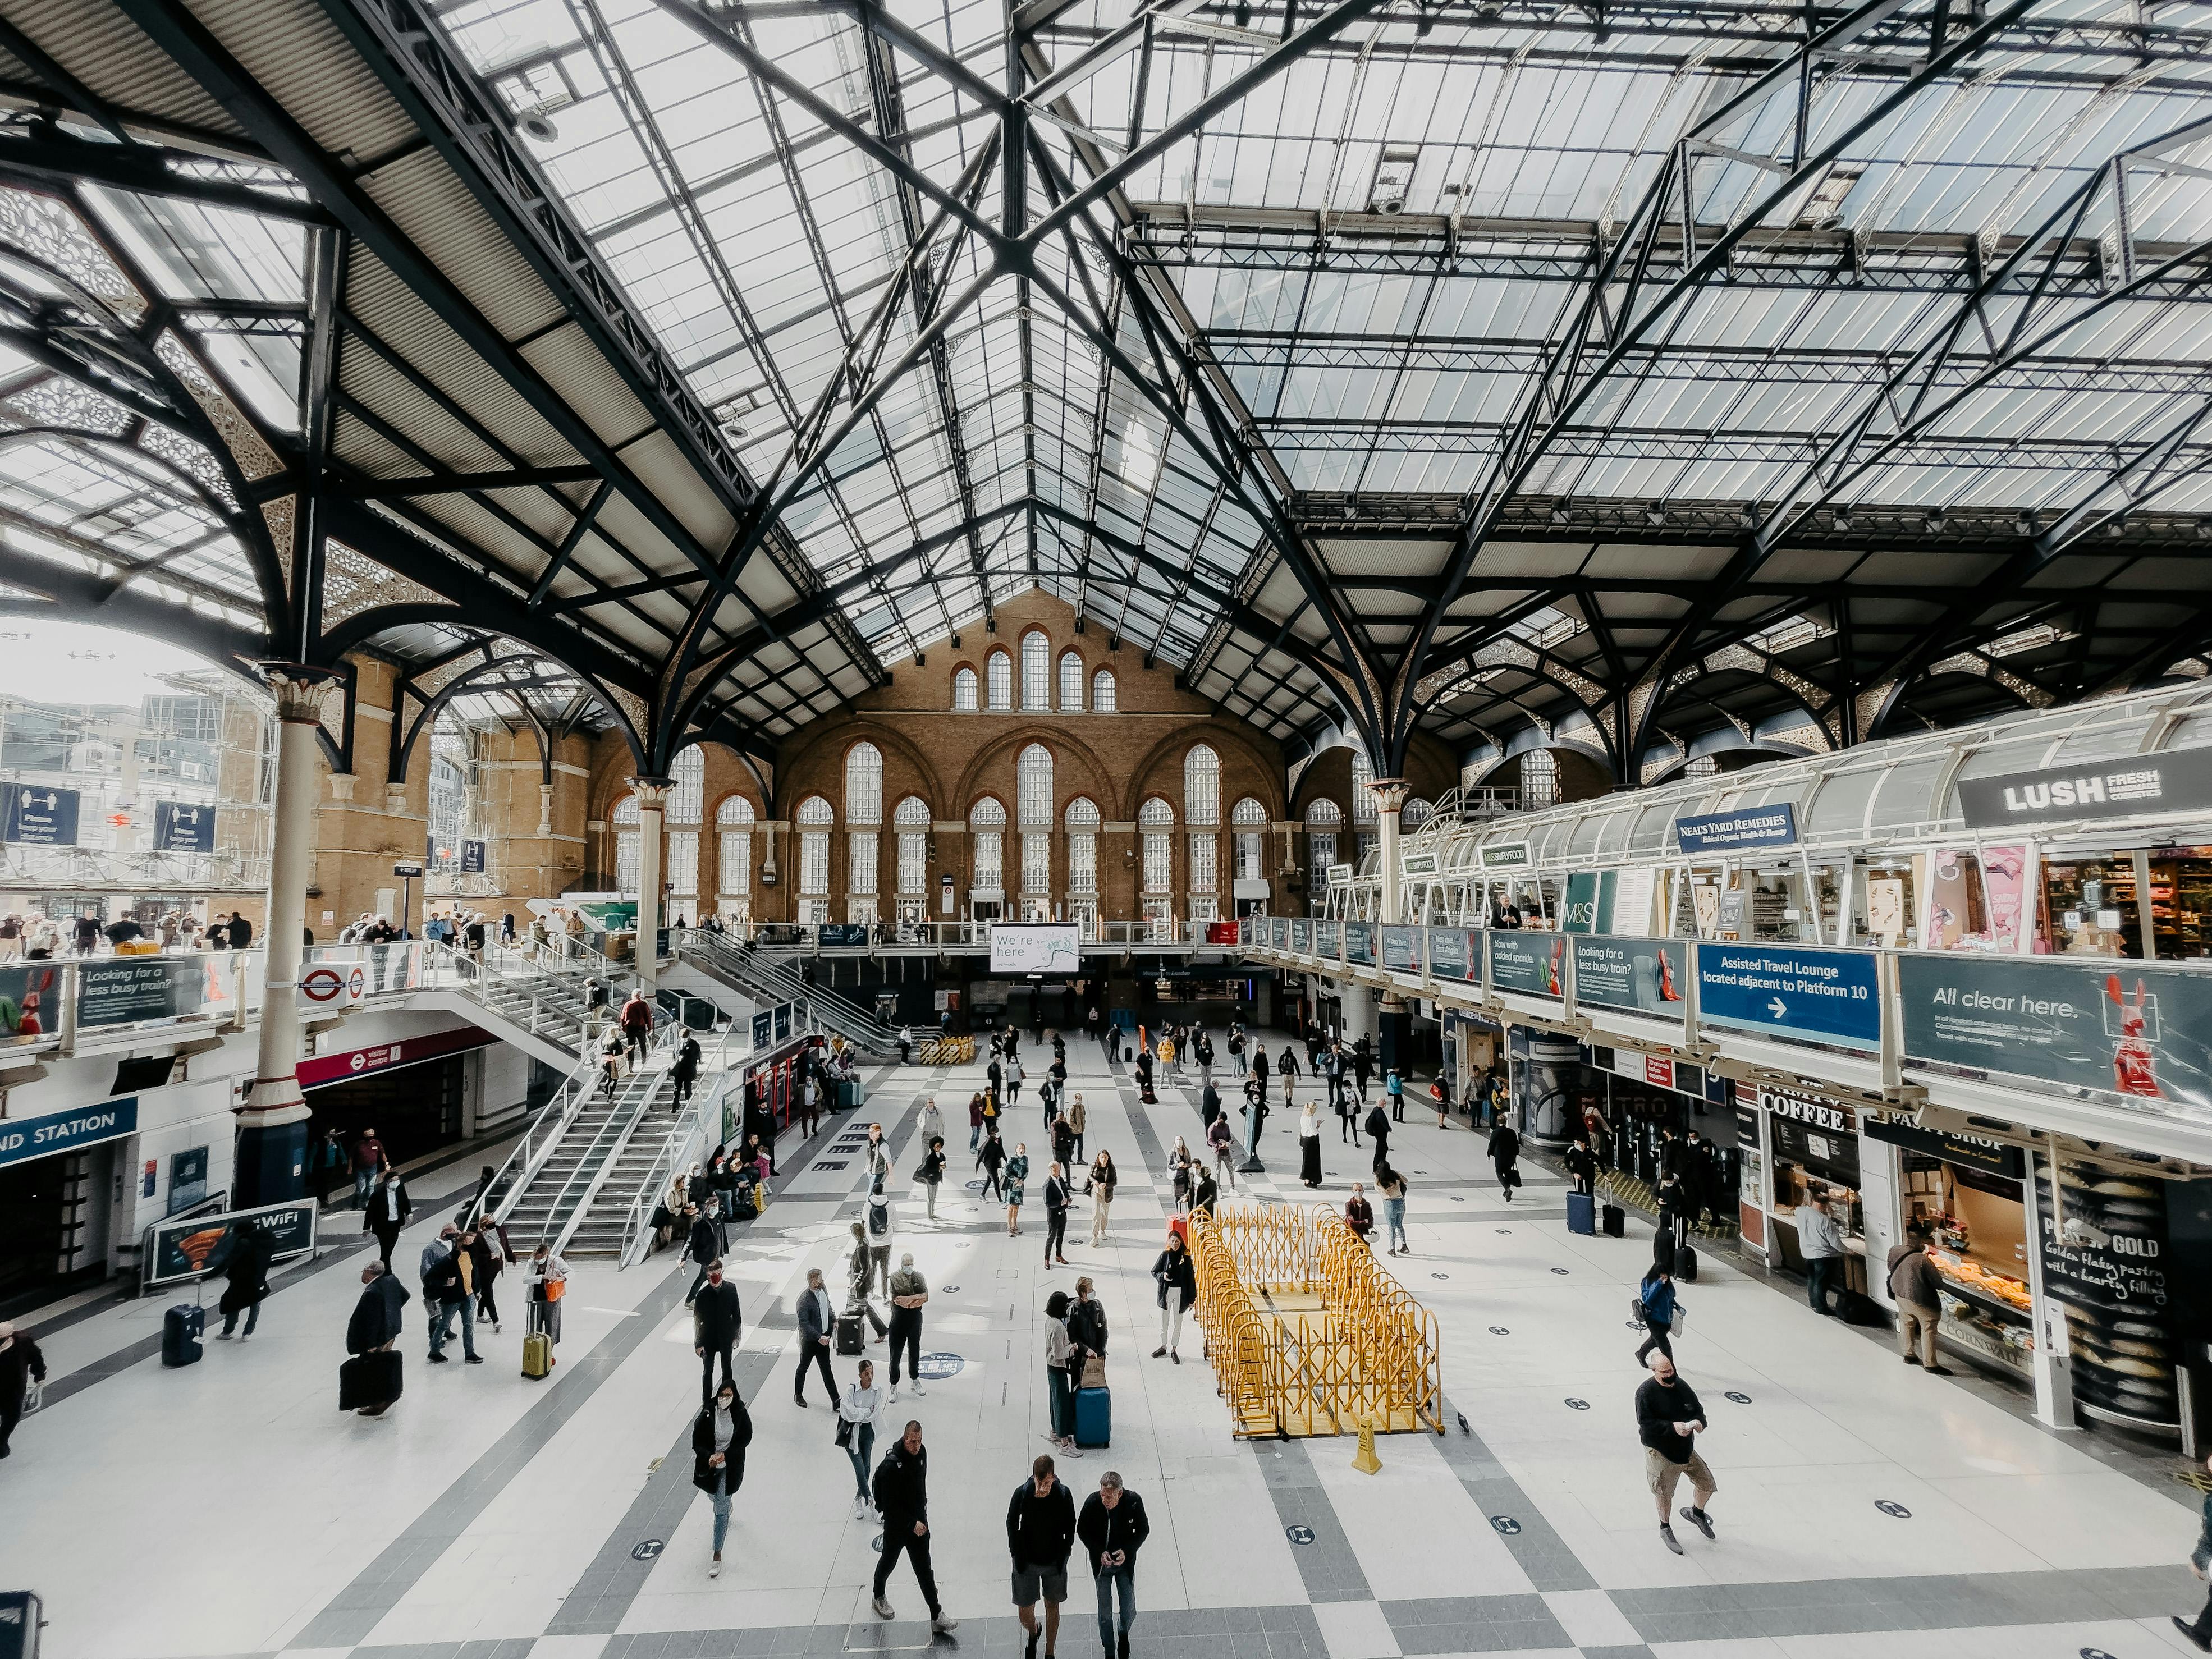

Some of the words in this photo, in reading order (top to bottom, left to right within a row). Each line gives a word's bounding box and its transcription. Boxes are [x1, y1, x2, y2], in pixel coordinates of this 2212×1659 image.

[2106, 769, 2160, 787] FRESH
[2003, 777, 2105, 811] LUSH
[1680, 824, 1708, 837] NEAL'S
[1708, 822, 1734, 834] YARD
[1734, 814, 1787, 831] REMEDIES
[1563, 902, 1593, 924] M&S
[996, 934, 1033, 945] We're
[1494, 939, 1506, 949] Now
[1506, 940, 1518, 950] with
[997, 946, 1024, 956] here
[1495, 952, 1512, 962] added
[1578, 946, 1605, 960] Looking
[1606, 947, 1617, 959] for
[1618, 951, 1624, 960] a
[86, 969, 132, 982] Looking
[136, 968, 150, 978] for
[1579, 959, 1592, 970] less
[1592, 960, 1610, 975] busy
[1610, 963, 1632, 975] train?
[1721, 956, 1761, 971] Assisted
[1762, 959, 1793, 974] Travel
[1795, 962, 1839, 979] Lounge
[85, 985, 109, 996] less
[111, 983, 139, 995] busy
[140, 978, 172, 991] train?
[1703, 970, 1736, 985] located
[1738, 975, 1780, 989] adjacent
[1783, 980, 1795, 992] to
[1797, 980, 1848, 997] Platform
[1850, 985, 1868, 1000] 10
[1932, 987, 1957, 1005] All
[1962, 989, 2016, 1011] clear
[2021, 995, 2078, 1019] here.
[368, 1048, 388, 1058] visitor
[368, 1056, 388, 1066] centre
[1760, 1092, 1844, 1131] COFFEE
[34, 1112, 115, 1143] STATION
[1892, 1113, 1944, 1135] PAS
[261, 1212, 298, 1227] WiFi
[2045, 1241, 2078, 1261] Golden
[2113, 1235, 2159, 1258] GOLD
[2046, 1262, 2068, 1275] with
[2081, 1268, 2128, 1299] hearty
